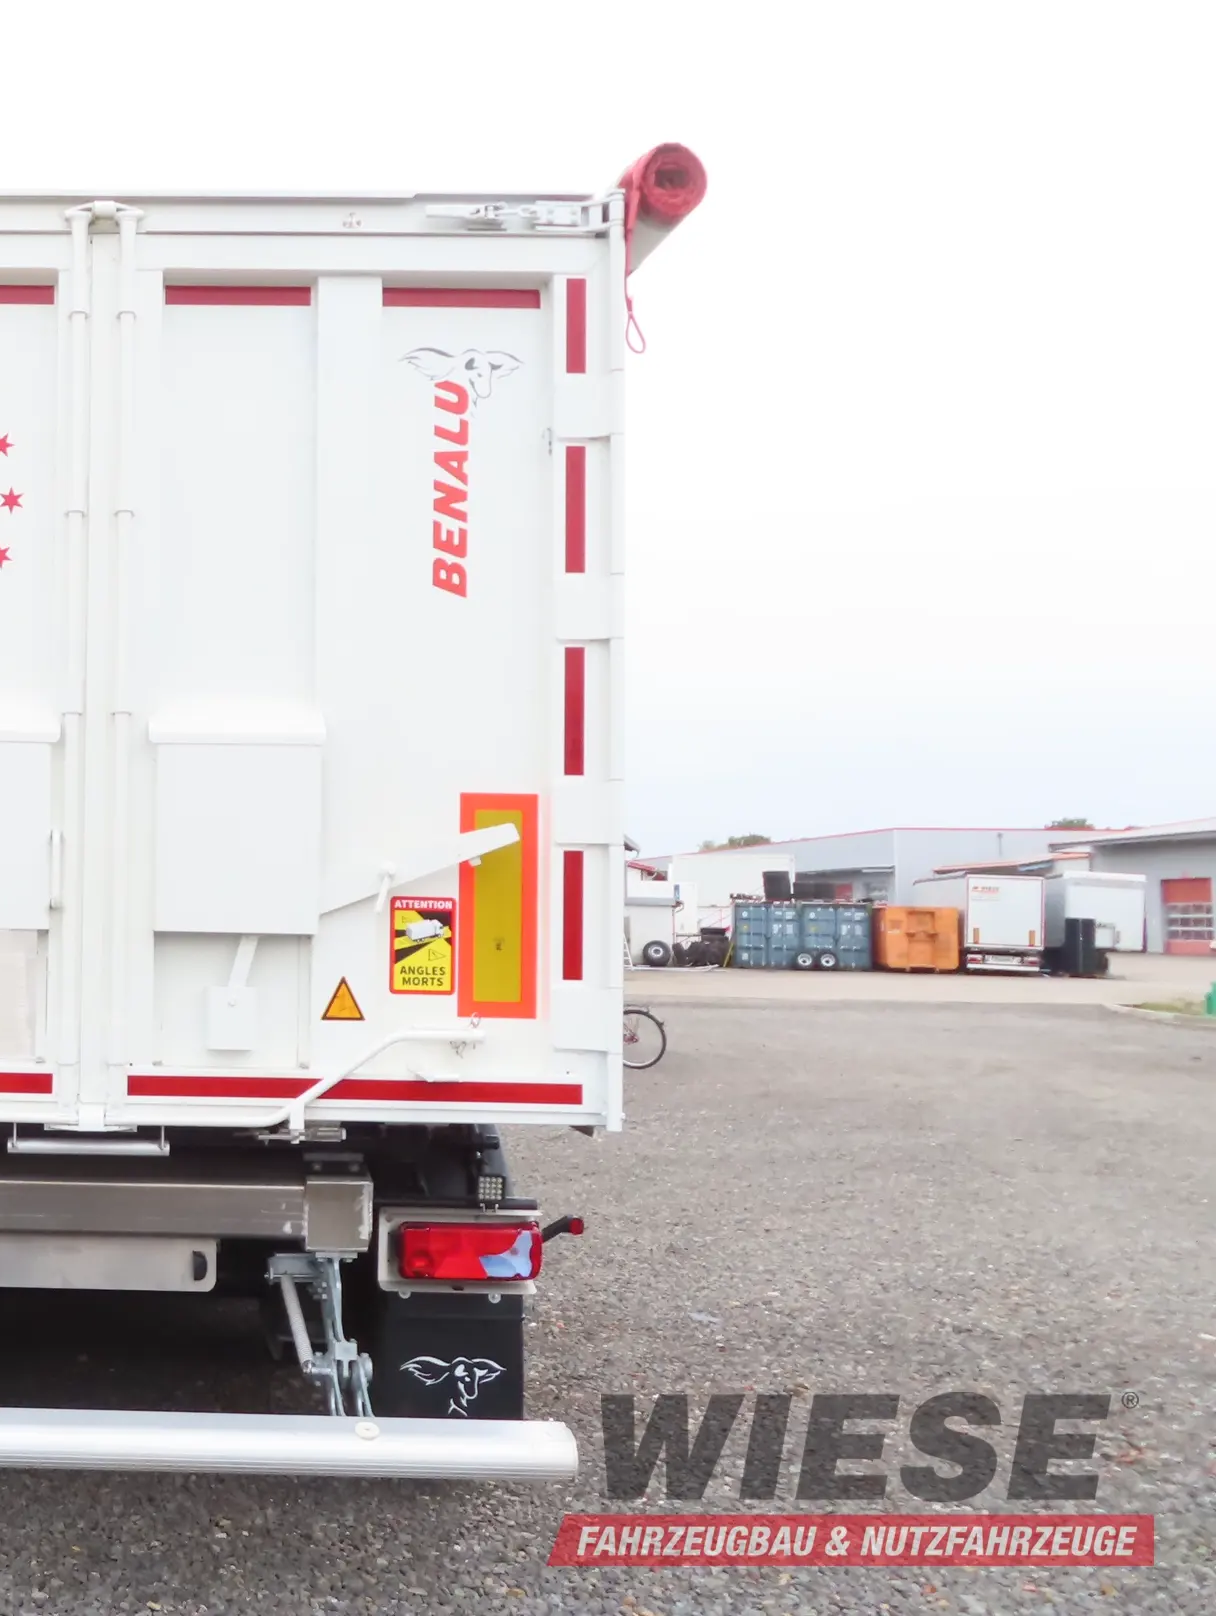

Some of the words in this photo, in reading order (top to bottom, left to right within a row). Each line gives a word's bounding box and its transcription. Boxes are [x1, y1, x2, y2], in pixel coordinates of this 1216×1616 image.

[432, 380, 469, 599] BENALU
[395, 900, 453, 910] ATTENTION
[400, 966, 446, 976] ANGLES
[402, 977, 444, 987] MORTS
